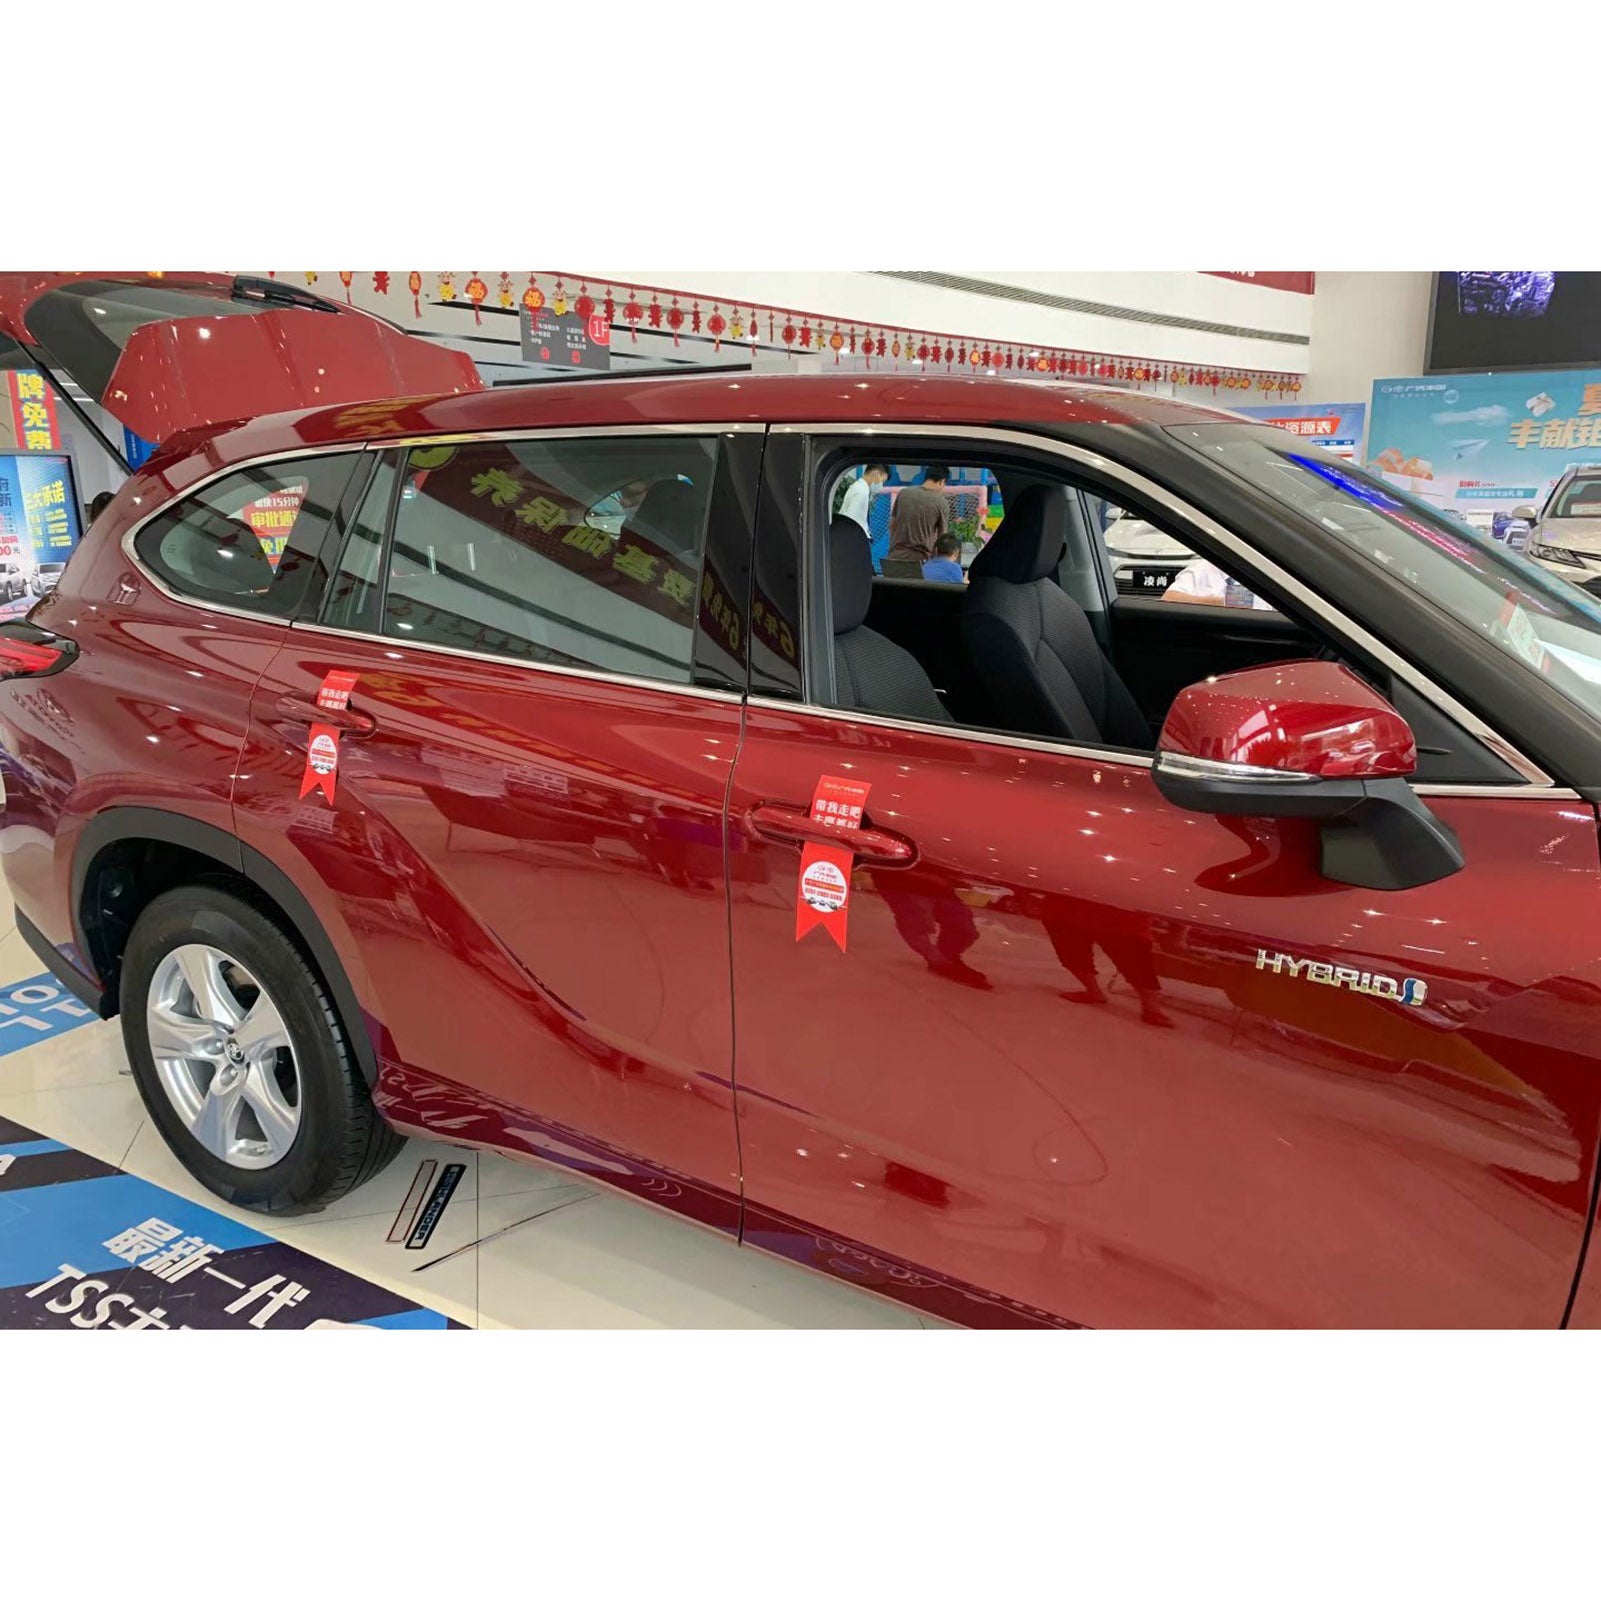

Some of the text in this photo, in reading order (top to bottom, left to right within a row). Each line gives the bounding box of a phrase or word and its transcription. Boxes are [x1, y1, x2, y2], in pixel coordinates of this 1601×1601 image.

[1143, 576, 1168, 587] 凌尚
[815, 799, 862, 817] 带我走吧
[1255, 949, 1399, 999] HYBRID
[102, 1217, 311, 1329] 最新一代
